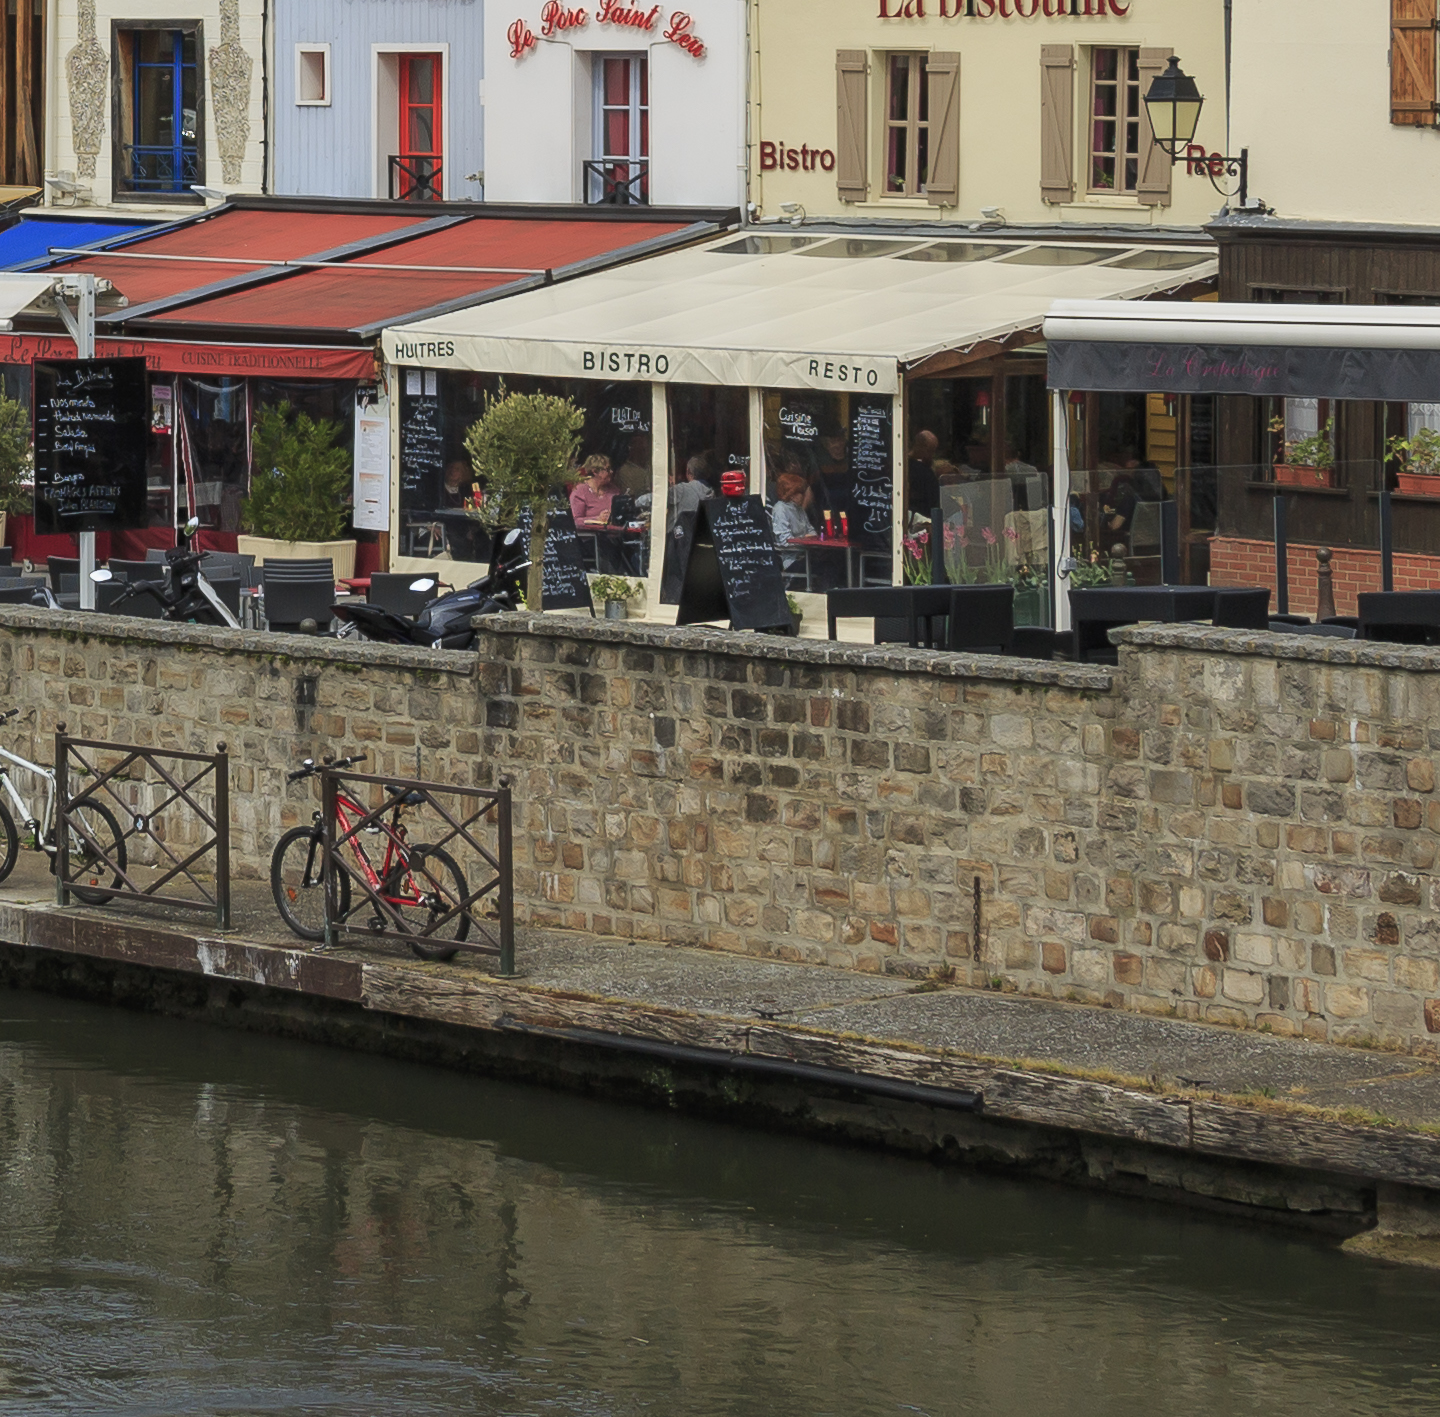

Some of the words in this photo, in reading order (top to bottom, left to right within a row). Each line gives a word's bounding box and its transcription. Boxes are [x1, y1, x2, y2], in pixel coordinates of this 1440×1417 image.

[507, 18, 537, 59] Le
[662, 11, 707, 59] Leu
[759, 140, 836, 172] Bistro
[3, 336, 28, 364] Le
[181, 350, 225, 366] CUISINE
[227, 352, 322, 370] TRADITIONNELLE
[395, 340, 455, 360] HUITRES
[582, 351, 670, 375] BISTRO
[808, 359, 879, 387] RESTO
[778, 406, 812, 424] Cuisine
